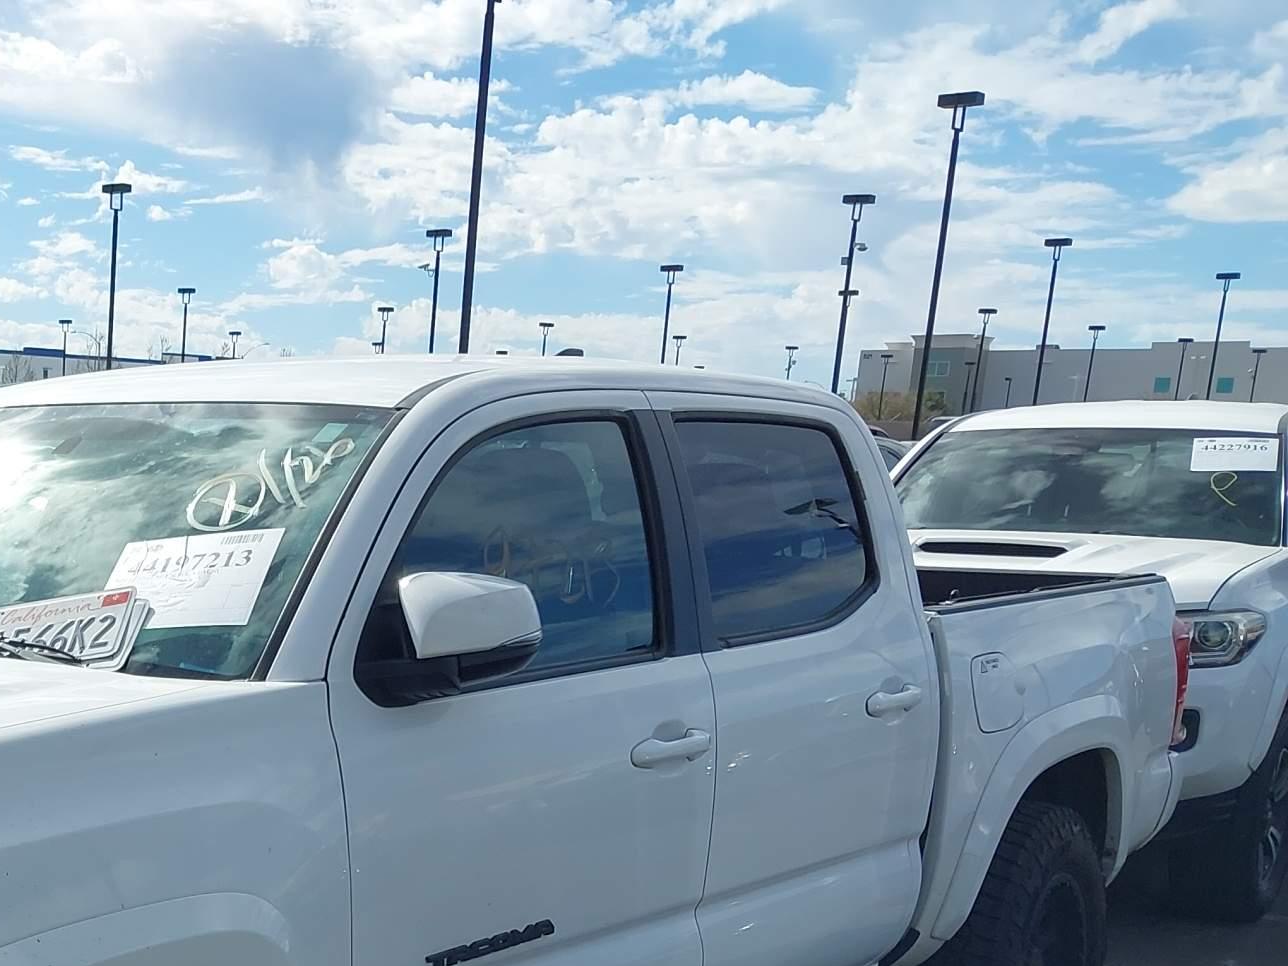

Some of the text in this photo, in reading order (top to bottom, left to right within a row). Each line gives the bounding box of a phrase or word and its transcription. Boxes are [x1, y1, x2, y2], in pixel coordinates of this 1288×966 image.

[1201, 443, 1268, 452] 44227916
[127, 549, 253, 576] 44197213
[1, 601, 98, 627] California
